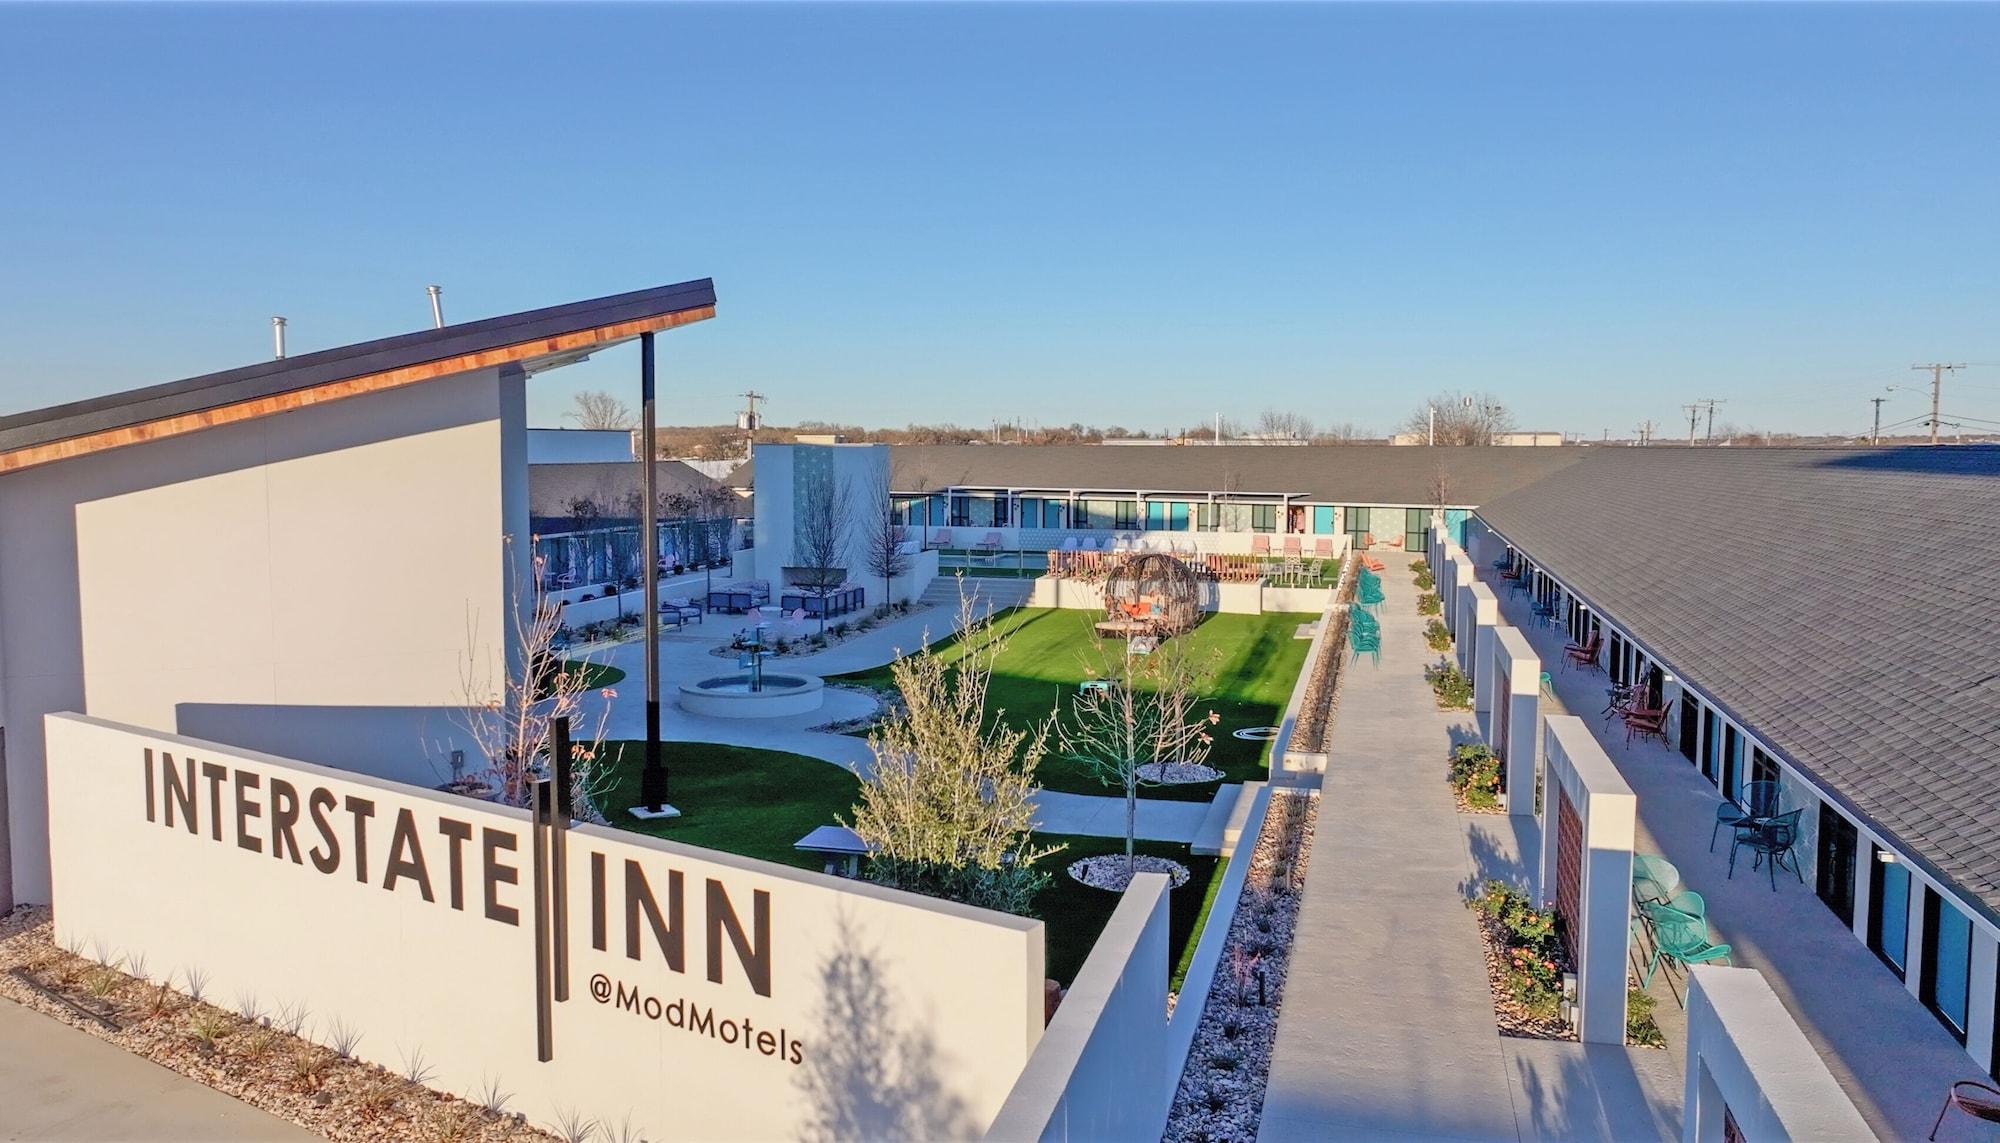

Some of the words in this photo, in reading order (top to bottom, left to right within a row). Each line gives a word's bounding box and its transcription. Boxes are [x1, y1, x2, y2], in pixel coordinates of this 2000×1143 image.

[144, 748, 519, 927] INTERSTATE
[591, 851, 772, 998] INN
[589, 973, 804, 1066] @ModMotels
